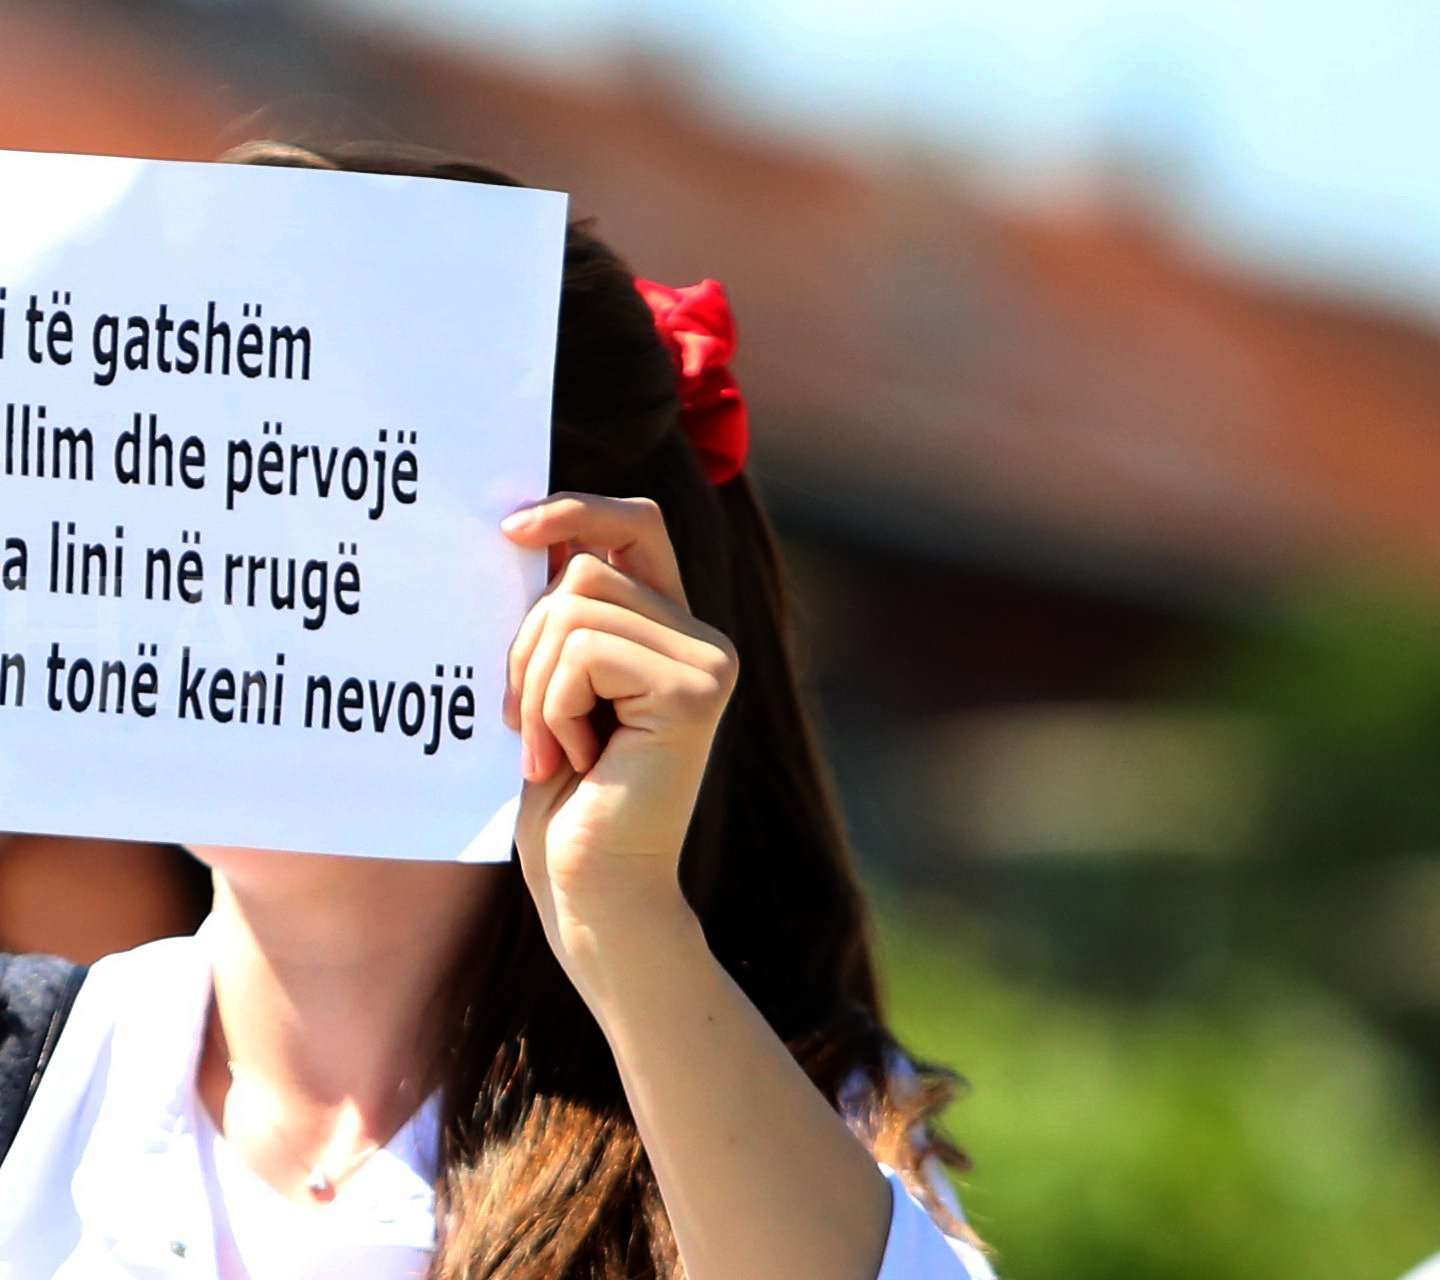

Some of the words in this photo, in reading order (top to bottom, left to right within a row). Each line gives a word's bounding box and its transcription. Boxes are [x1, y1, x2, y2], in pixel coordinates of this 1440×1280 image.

[24, 289, 75, 367] të
[91, 299, 313, 388] gatshëm
[113, 411, 207, 491] dhe
[225, 420, 420, 522] përvojë
[48, 519, 125, 599] lini
[144, 529, 205, 606] në
[223, 542, 362, 632] rrugë
[45, 641, 160, 719] tonë
[176, 645, 287, 727] keni
[303, 662, 477, 757] nevojë
